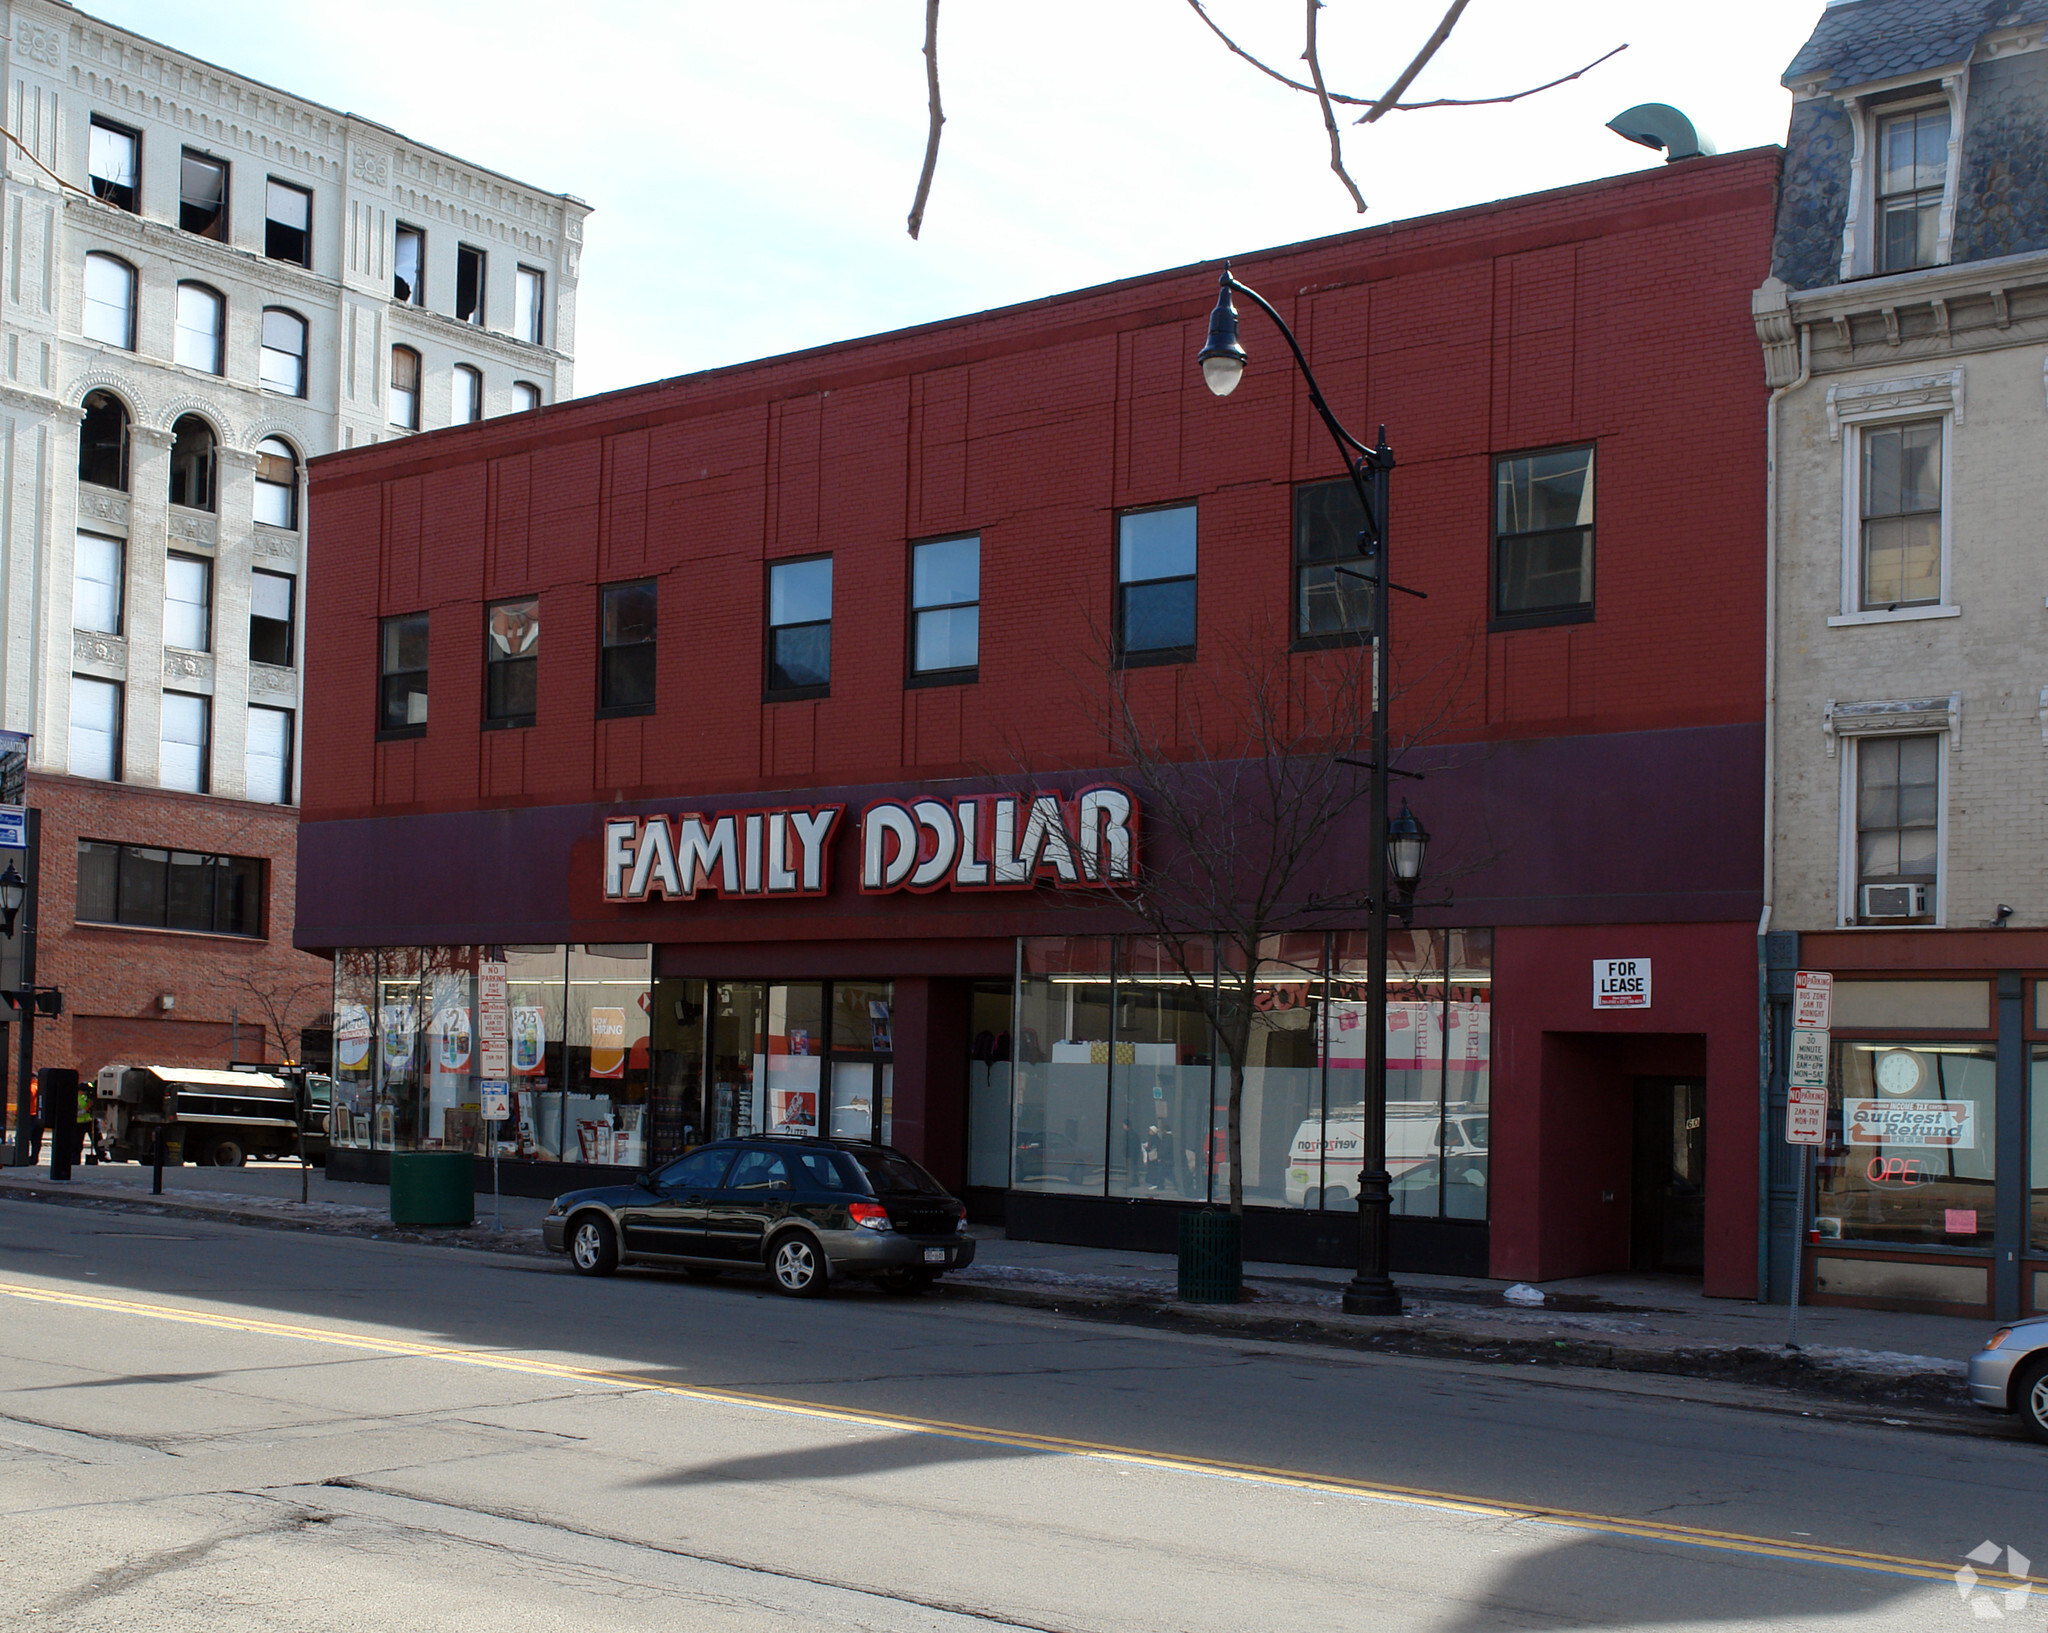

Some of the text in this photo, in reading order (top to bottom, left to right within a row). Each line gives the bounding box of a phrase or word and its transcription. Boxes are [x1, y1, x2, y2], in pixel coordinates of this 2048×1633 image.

[607, 790, 1134, 898] FAMILY DOLLAR
[488, 966, 498, 975] NO
[1608, 961, 1636, 976] FOR
[1601, 977, 1644, 992] LEASE
[1797, 975, 1807, 986] NO
[593, 1017, 612, 1025] NOW
[593, 1025, 623, 1035] HIRING
[1416, 1003, 1428, 1059] Hanes
[1467, 1003, 1479, 1061] Hanes
[1806, 1037, 1816, 1045] 30
[1799, 1045, 1822, 1053] MINUTE
[1797, 1053, 1823, 1062] PARKING
[1790, 1091, 1800, 1101] NO
[1890, 1102, 1914, 1110] INCOME
[1853, 1110, 1942, 1124] Quickest
[1687, 1118, 1699, 1128] 60
[1883, 1123, 1963, 1137] Refund
[1867, 1156, 1938, 1185] OPEN
